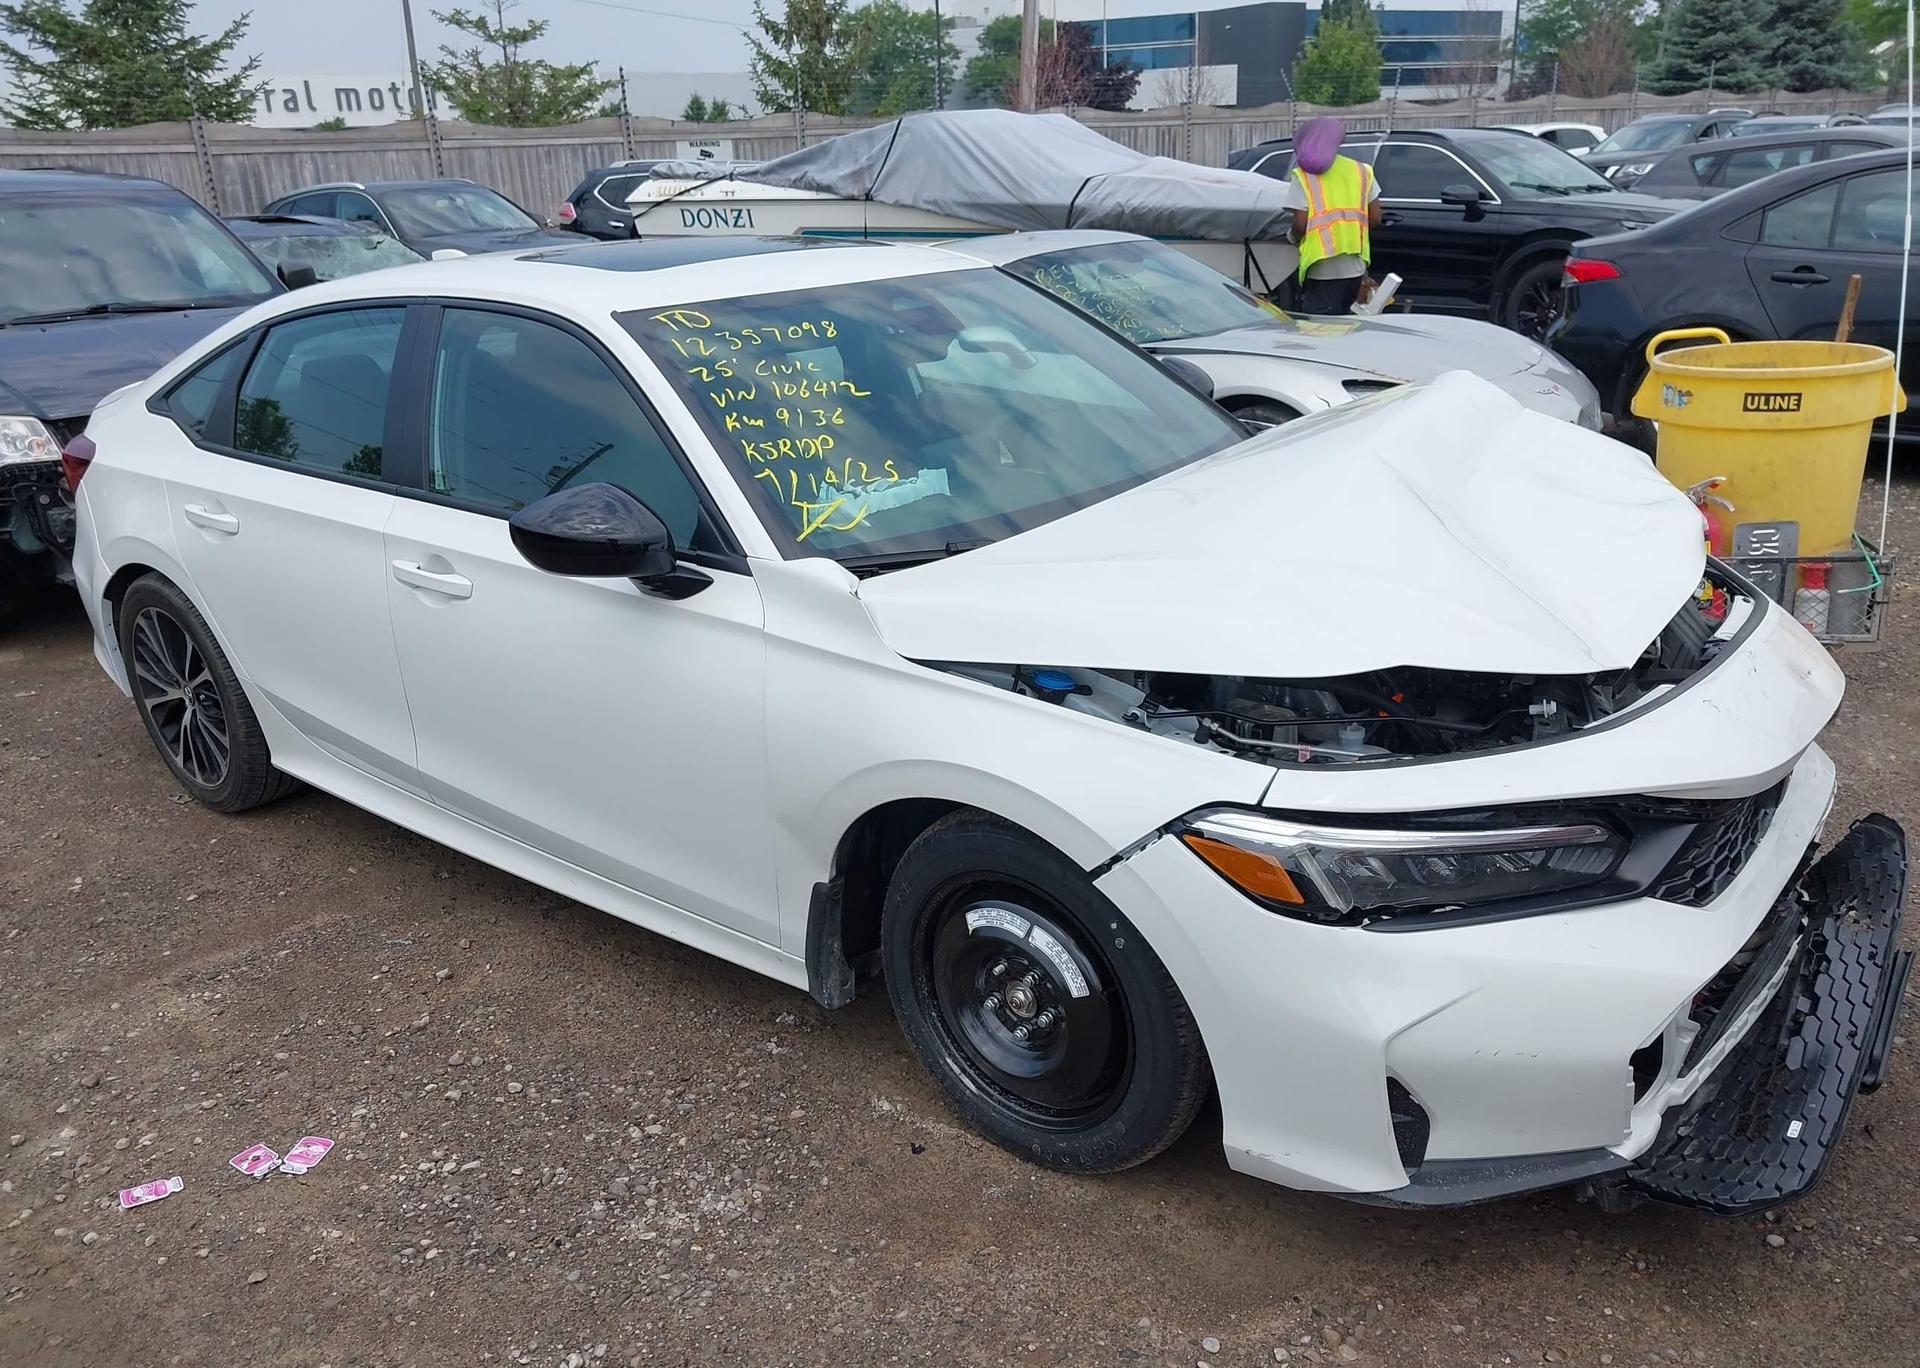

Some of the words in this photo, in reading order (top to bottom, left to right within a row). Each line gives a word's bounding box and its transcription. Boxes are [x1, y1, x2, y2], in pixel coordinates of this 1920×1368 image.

[688, 140, 721, 148] WARNING
[680, 208, 755, 228] DONZI
[671, 320, 837, 359] 12357098
[710, 381, 756, 408] VIN
[771, 378, 872, 401] 106412
[1746, 395, 1799, 410] ULINE
[775, 407, 845, 429] 9136
